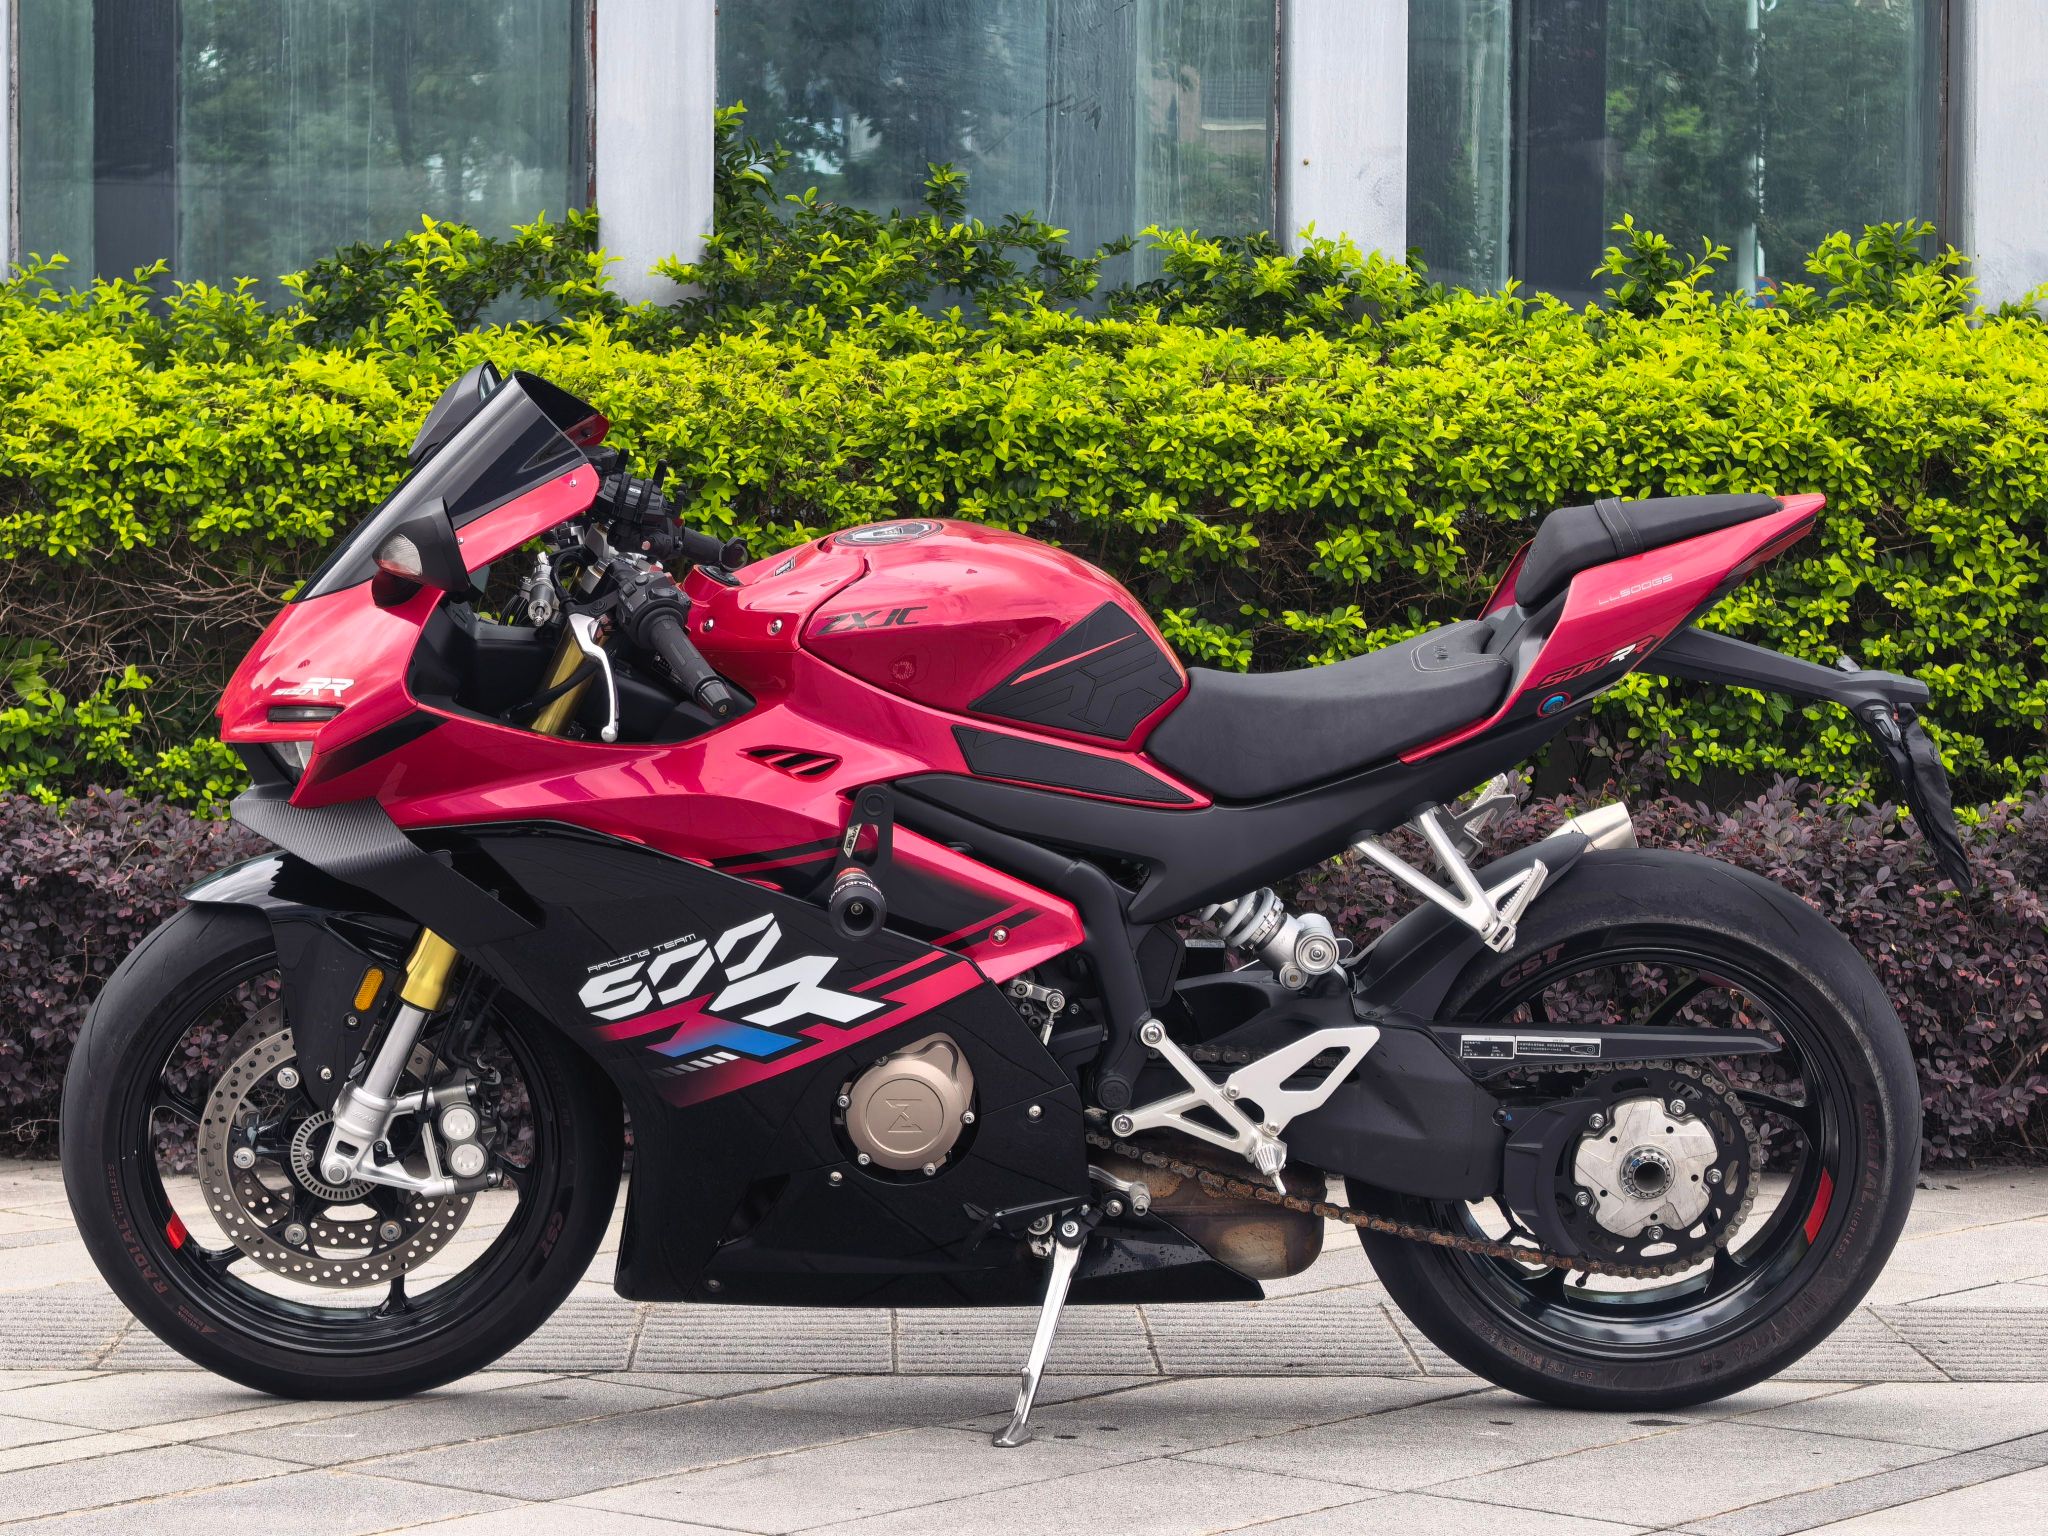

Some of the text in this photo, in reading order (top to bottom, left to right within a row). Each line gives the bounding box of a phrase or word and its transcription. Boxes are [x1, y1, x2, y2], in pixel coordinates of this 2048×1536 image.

[587, 933, 696, 973] RACING TEAM
[1500, 942, 1564, 989] CST
[119, 1218, 169, 1296] RADIAL
[535, 1210, 564, 1260] CST
